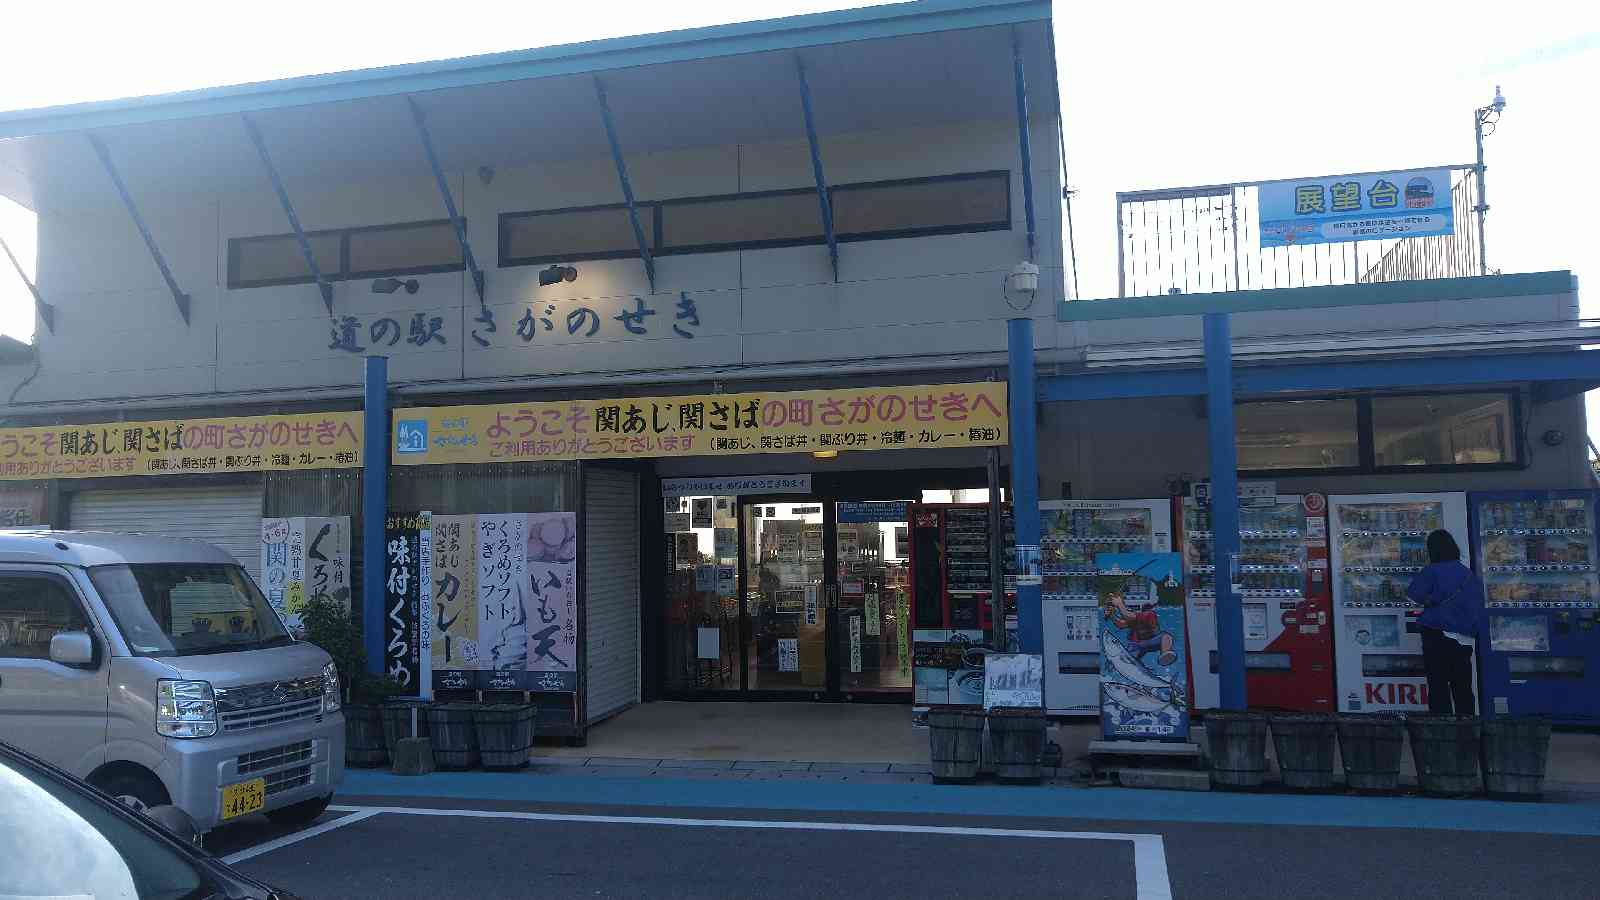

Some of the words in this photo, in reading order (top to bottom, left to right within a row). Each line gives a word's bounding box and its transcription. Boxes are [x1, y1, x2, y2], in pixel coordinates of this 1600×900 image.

[1295, 179, 1399, 215] 展望台
[328, 312, 447, 353] 道の駅
[471, 291, 700, 347] さがのせき
[490, 432, 696, 457] ご利用ありがとうございます
[435, 522, 447, 568] 関さば
[449, 522, 460, 568] 関あじ
[333, 557, 345, 584] 味付
[497, 520, 512, 620] くろめソフト
[387, 536, 411, 688] 味付くろめ
[435, 571, 463, 665] カレー
[530, 570, 569, 668] いも天
[1364, 683, 1429, 705] KIRI
